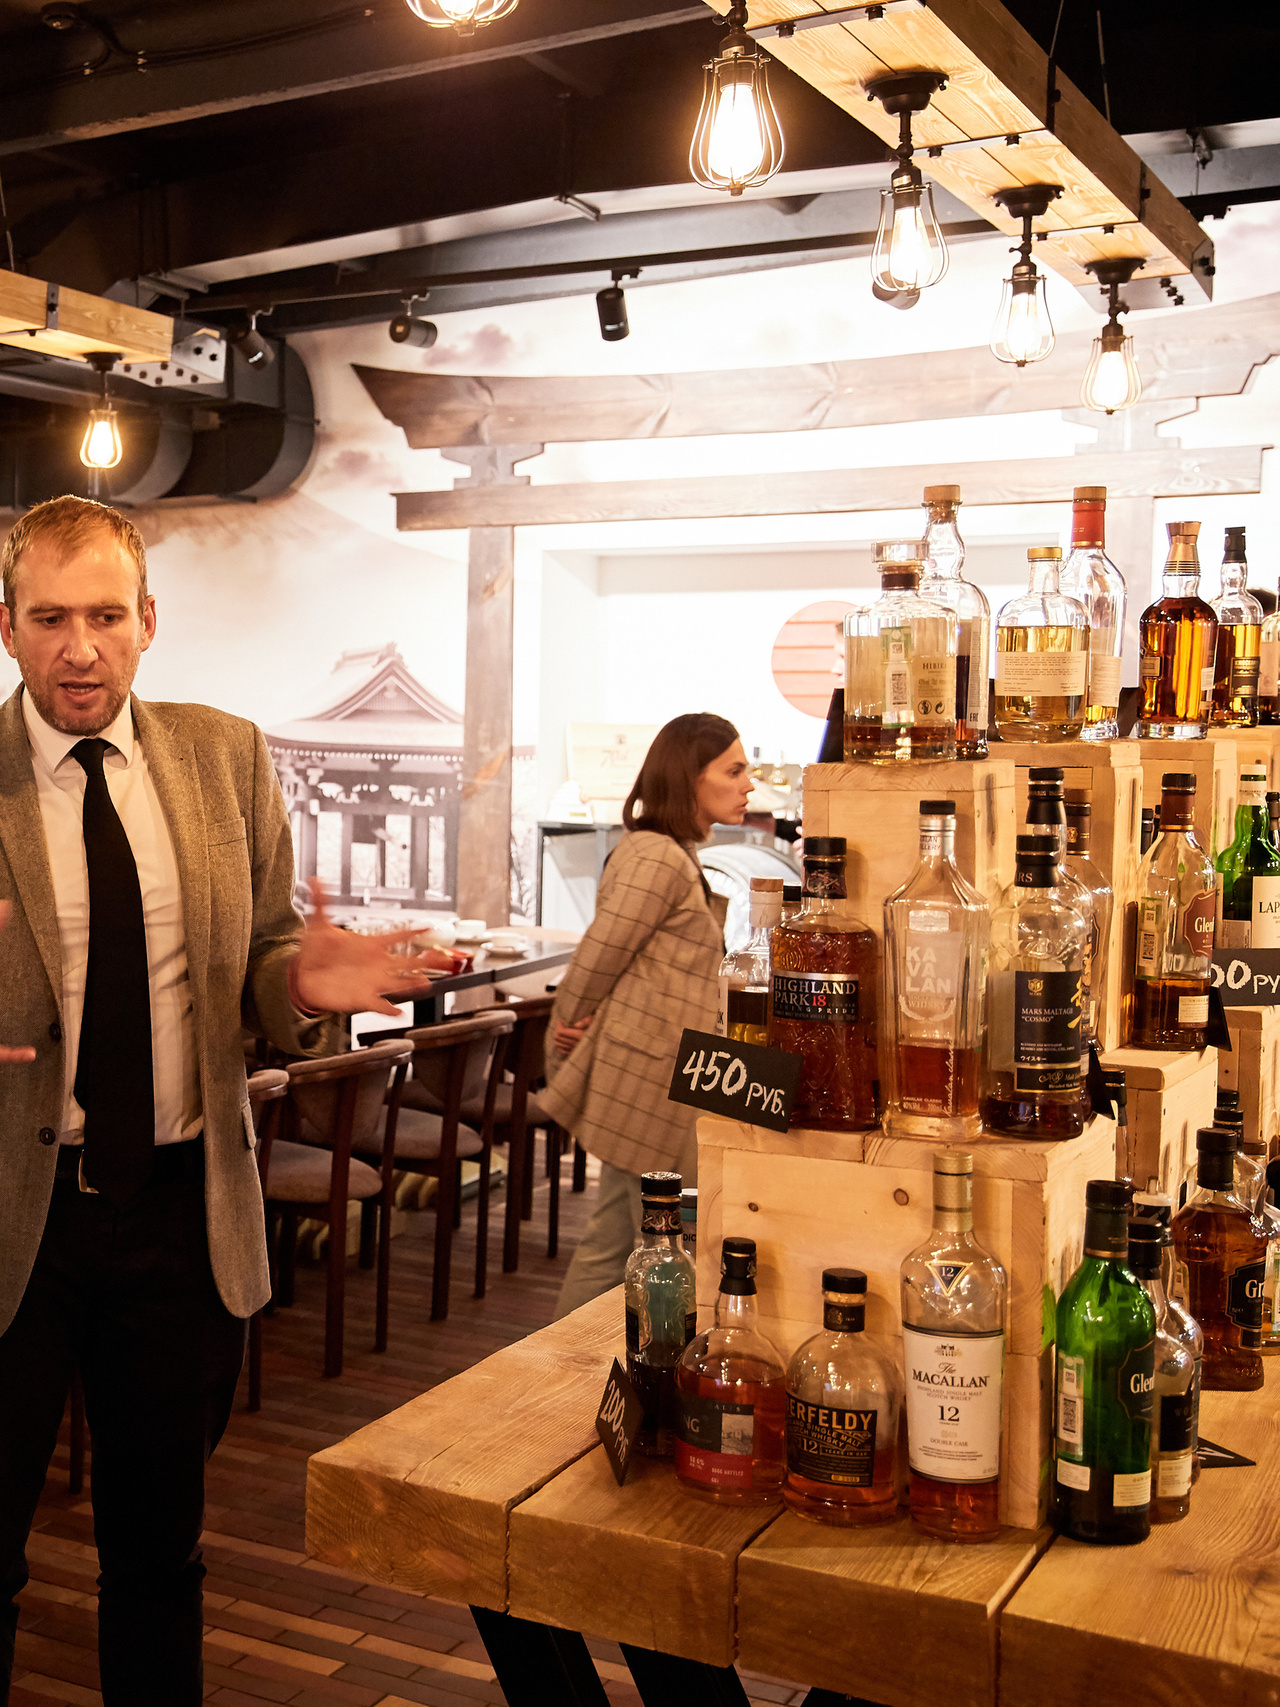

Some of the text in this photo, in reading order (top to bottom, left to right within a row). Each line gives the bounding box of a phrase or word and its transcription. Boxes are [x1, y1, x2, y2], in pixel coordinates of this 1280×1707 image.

[774, 977, 856, 995] HIGHLAND
[906, 977, 952, 994] LAN
[774, 990, 810, 1009] PARK
[812, 994, 827, 1007] 18
[1044, 1007, 1074, 1015] MALTAGE
[682, 1050, 748, 1096] 450
[941, 1267, 955, 1277] 12
[937, 1362, 957, 1374] The
[912, 1368, 989, 1388] MACALLAN
[600, 1379, 625, 1434] 200
[788, 1398, 872, 1431] ERFELDY
[938, 1404, 960, 1422] 12
[806, 1423, 837, 1438] SINGLE
[840, 1434, 862, 1448] MALT
[810, 1431, 845, 1448] WHISKY
[802, 1438, 819, 1454] 12
